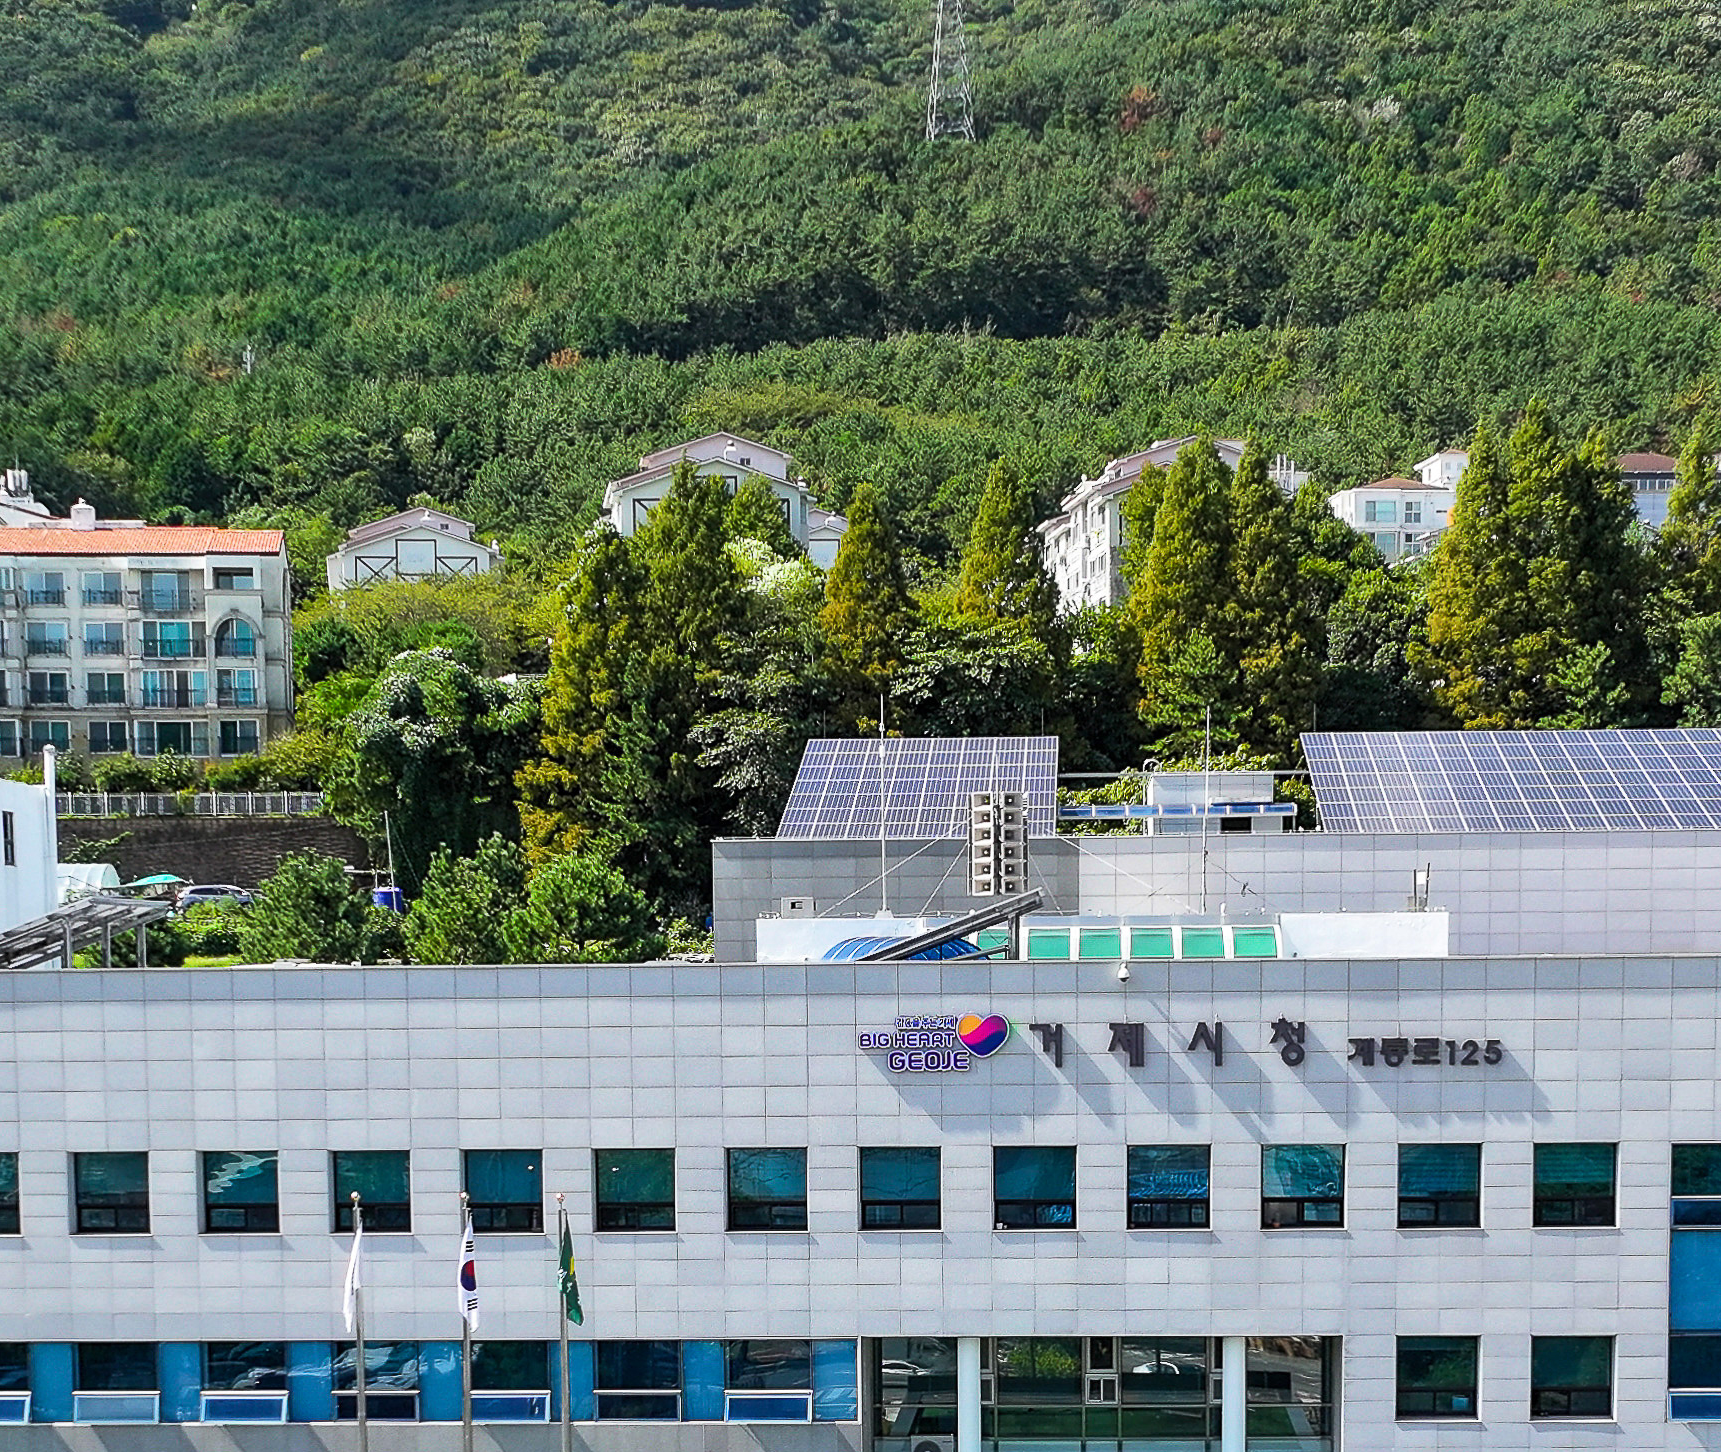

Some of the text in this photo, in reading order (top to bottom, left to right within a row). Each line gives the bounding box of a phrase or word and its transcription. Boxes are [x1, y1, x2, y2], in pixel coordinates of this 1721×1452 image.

[859, 1032, 955, 1048] BIG HEART
[888, 1050, 970, 1072] GEOJE
